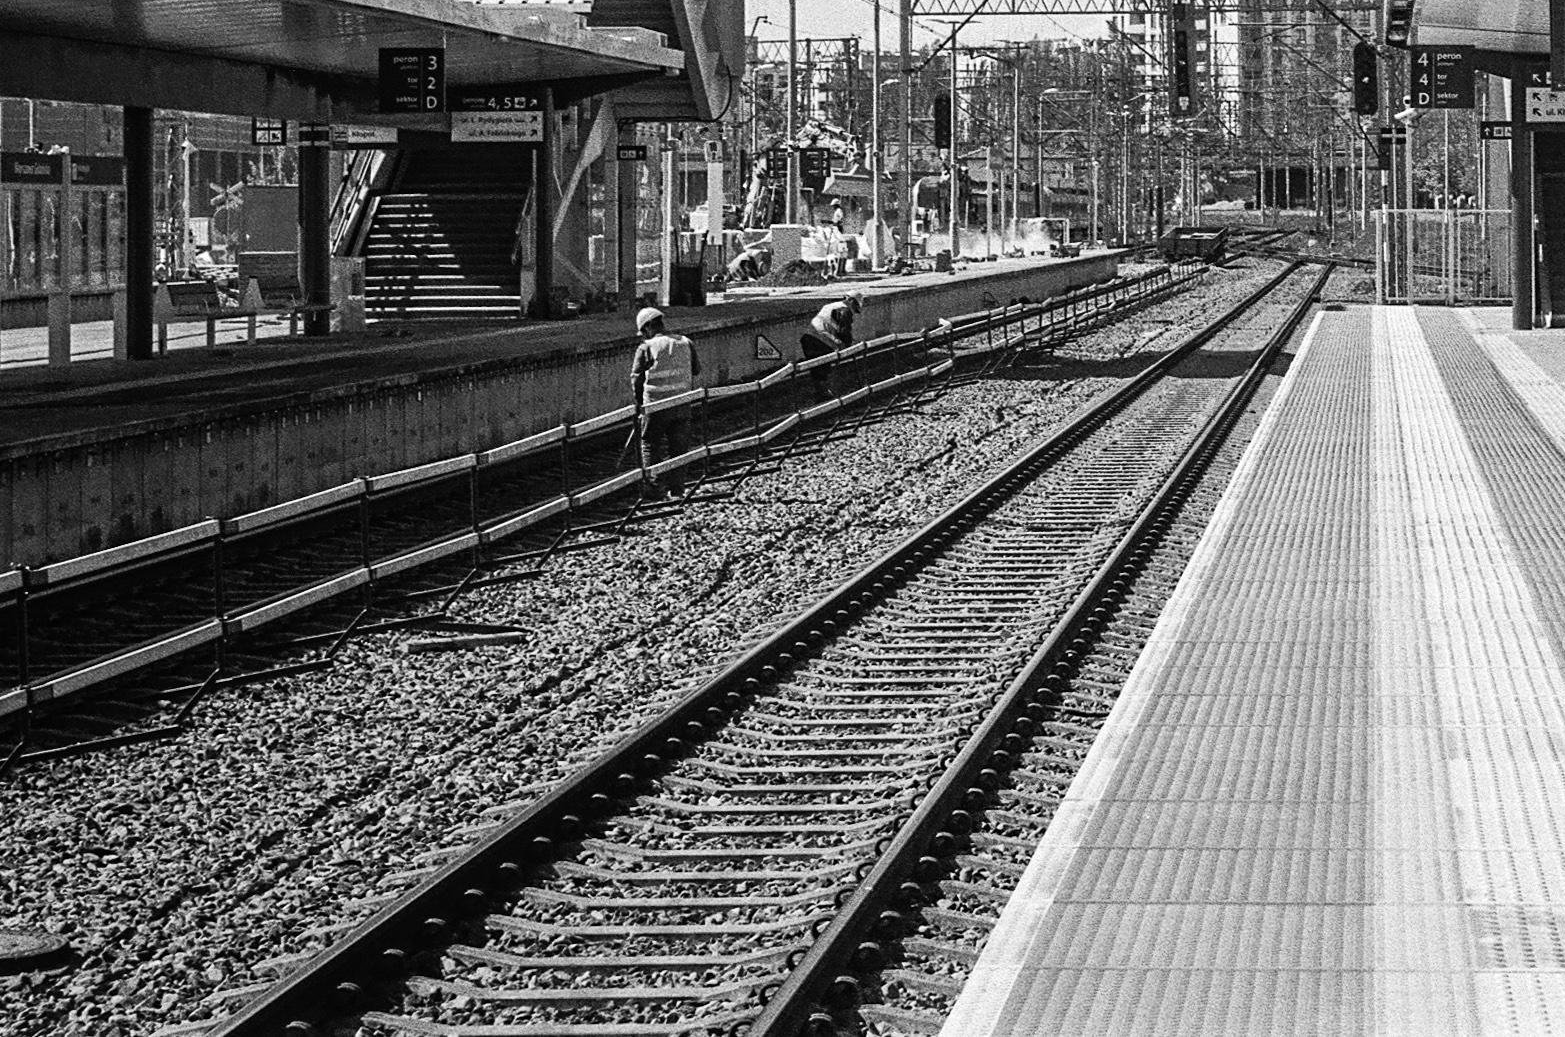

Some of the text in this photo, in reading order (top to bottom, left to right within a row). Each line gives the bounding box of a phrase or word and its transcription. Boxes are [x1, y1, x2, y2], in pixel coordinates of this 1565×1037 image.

[393, 55, 438, 71] peron 3
[1417, 52, 1462, 67] 4 peron
[427, 76, 436, 90] 2
[1419, 73, 1429, 86] 4
[396, 95, 418, 103] sektor
[426, 96, 438, 109] D
[503, 97, 512, 109] 5
[1418, 92, 1430, 105] D
[1546, 108, 1556, 116] ul.
